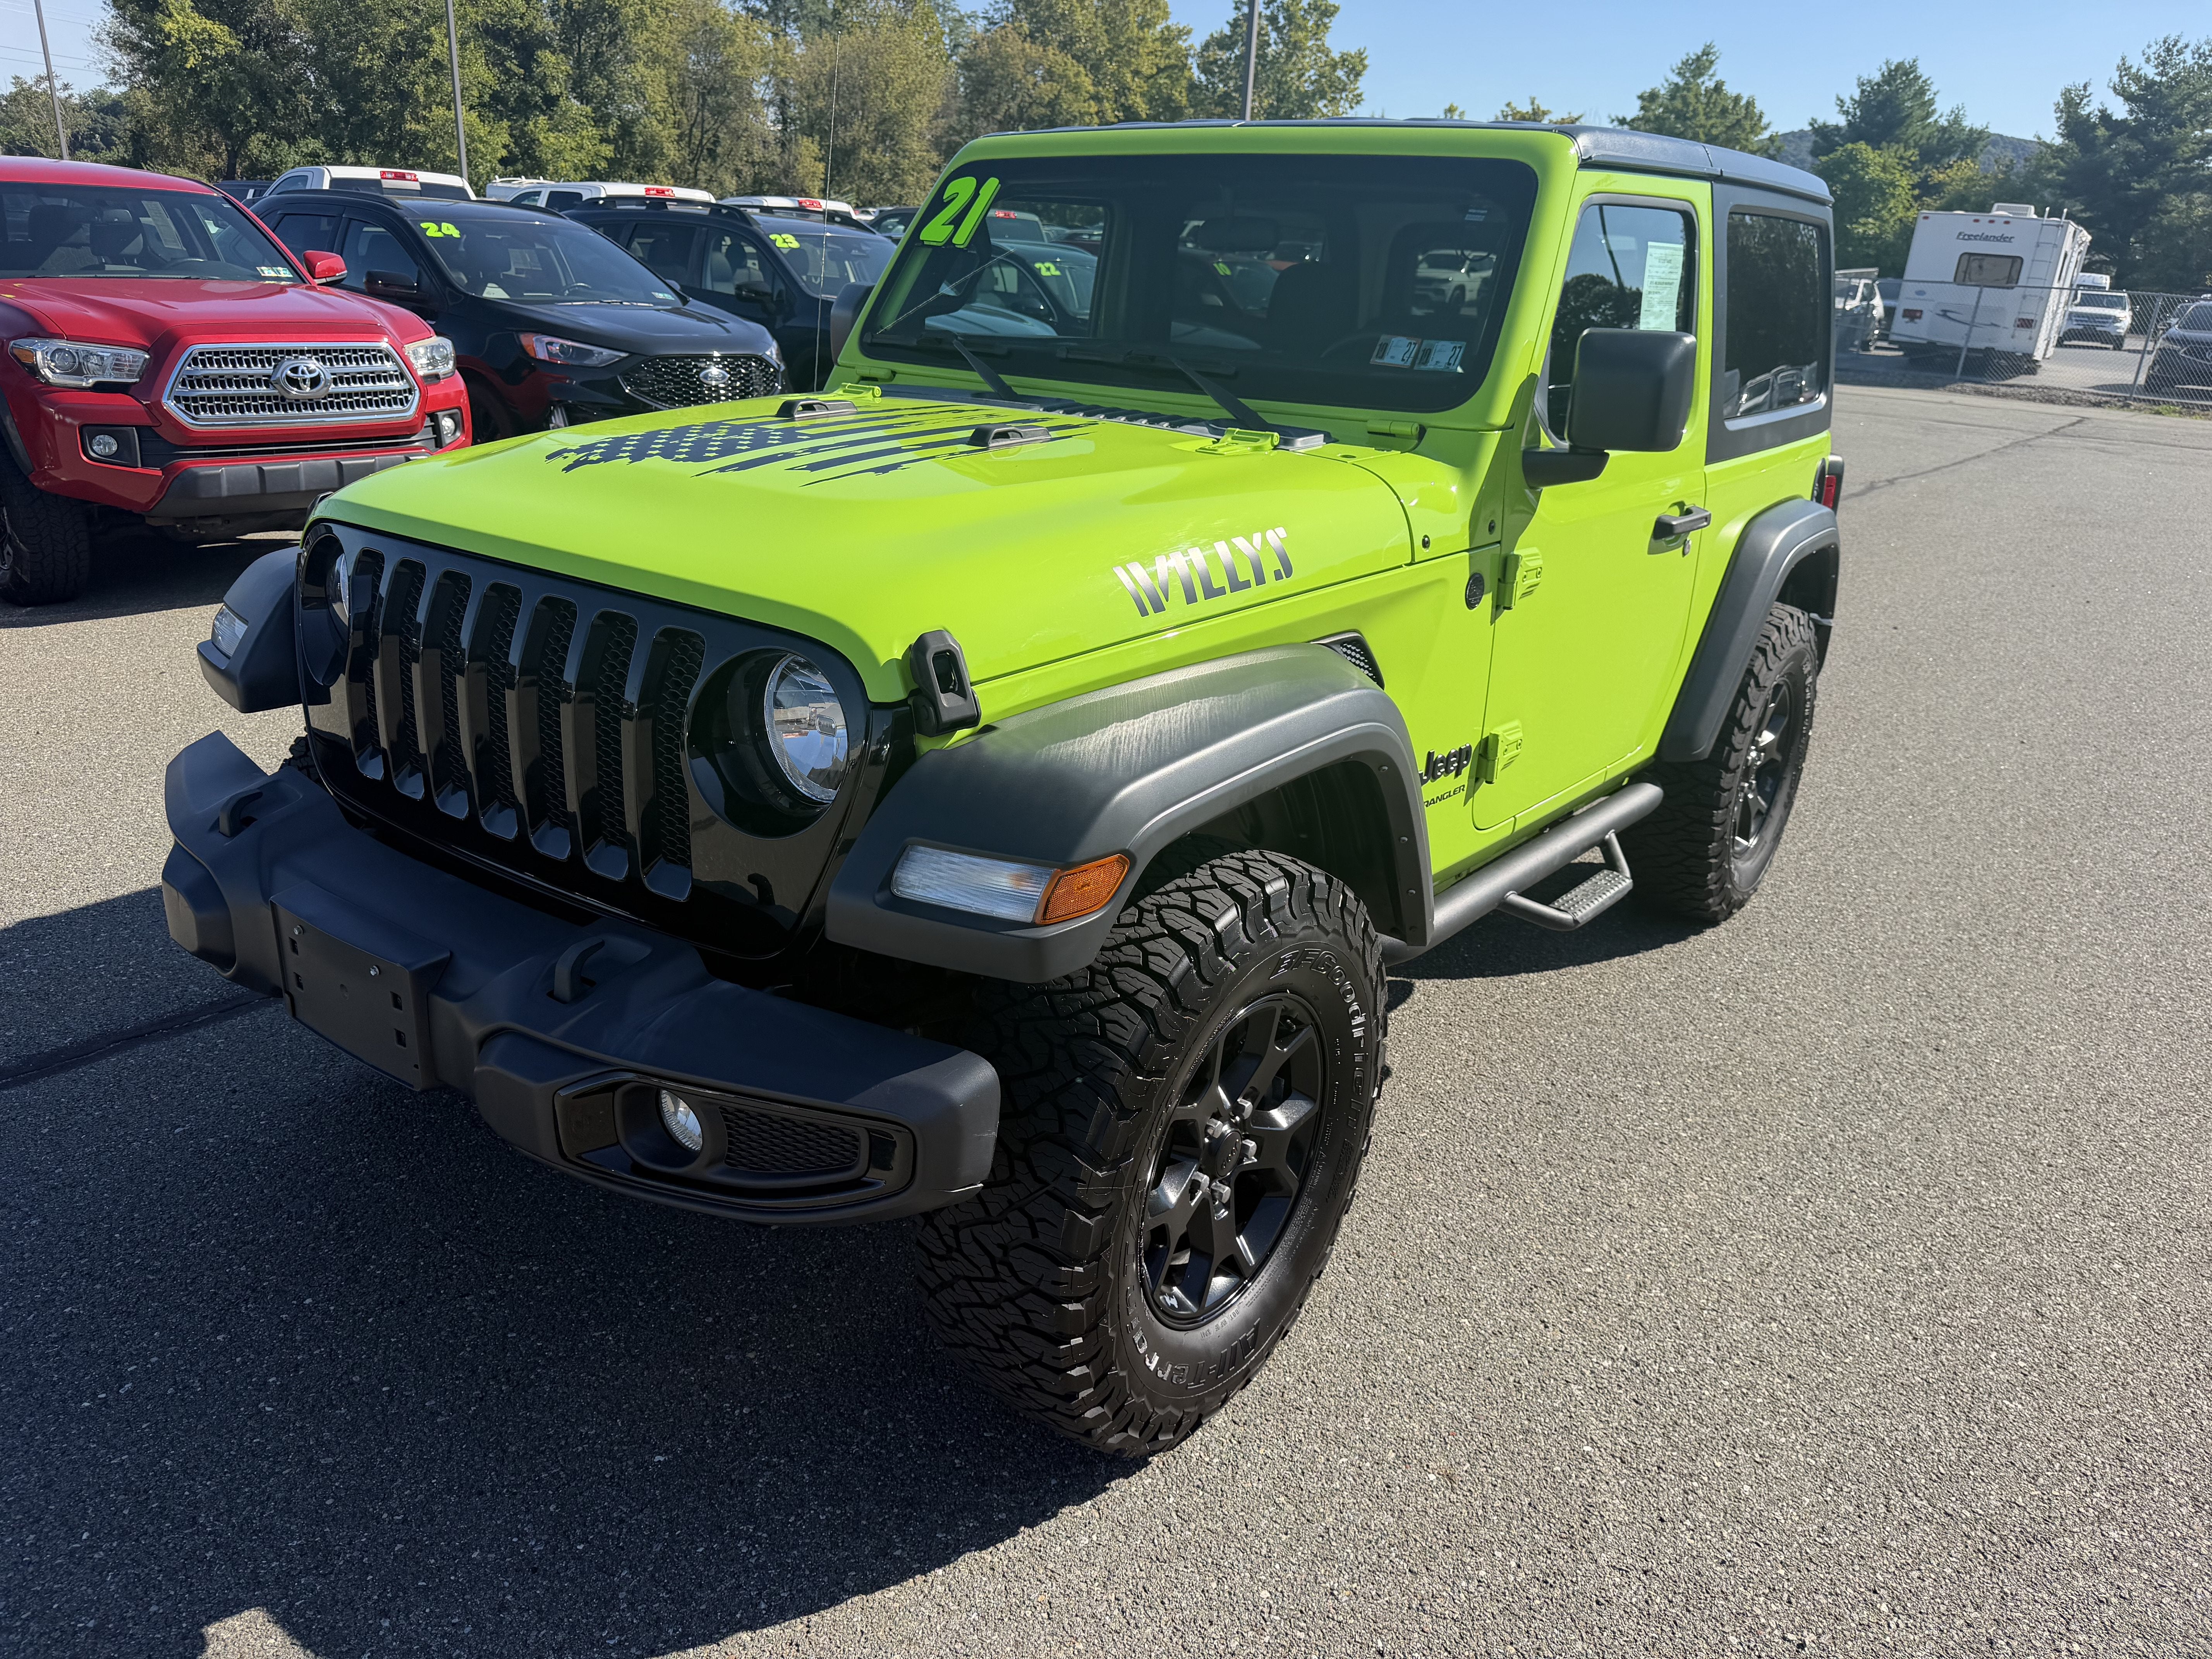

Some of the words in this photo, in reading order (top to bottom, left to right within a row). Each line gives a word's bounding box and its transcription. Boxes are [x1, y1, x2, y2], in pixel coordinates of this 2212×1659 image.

[920, 177, 1001, 249] 21
[421, 222, 461, 238] 24
[1956, 231, 2015, 243] Freelander
[769, 234, 800, 249] 23
[1034, 261, 1062, 276] 22
[1401, 341, 1417, 363] 27
[1447, 345, 1463, 367] 27
[1112, 526, 1294, 618] WILLYS
[1418, 743, 1472, 786] Jeep
[1424, 784, 1465, 808] RANGLER
[1268, 948, 1369, 1130] BFGoodrich
[1229, 1308, 1240, 1321] DOT
